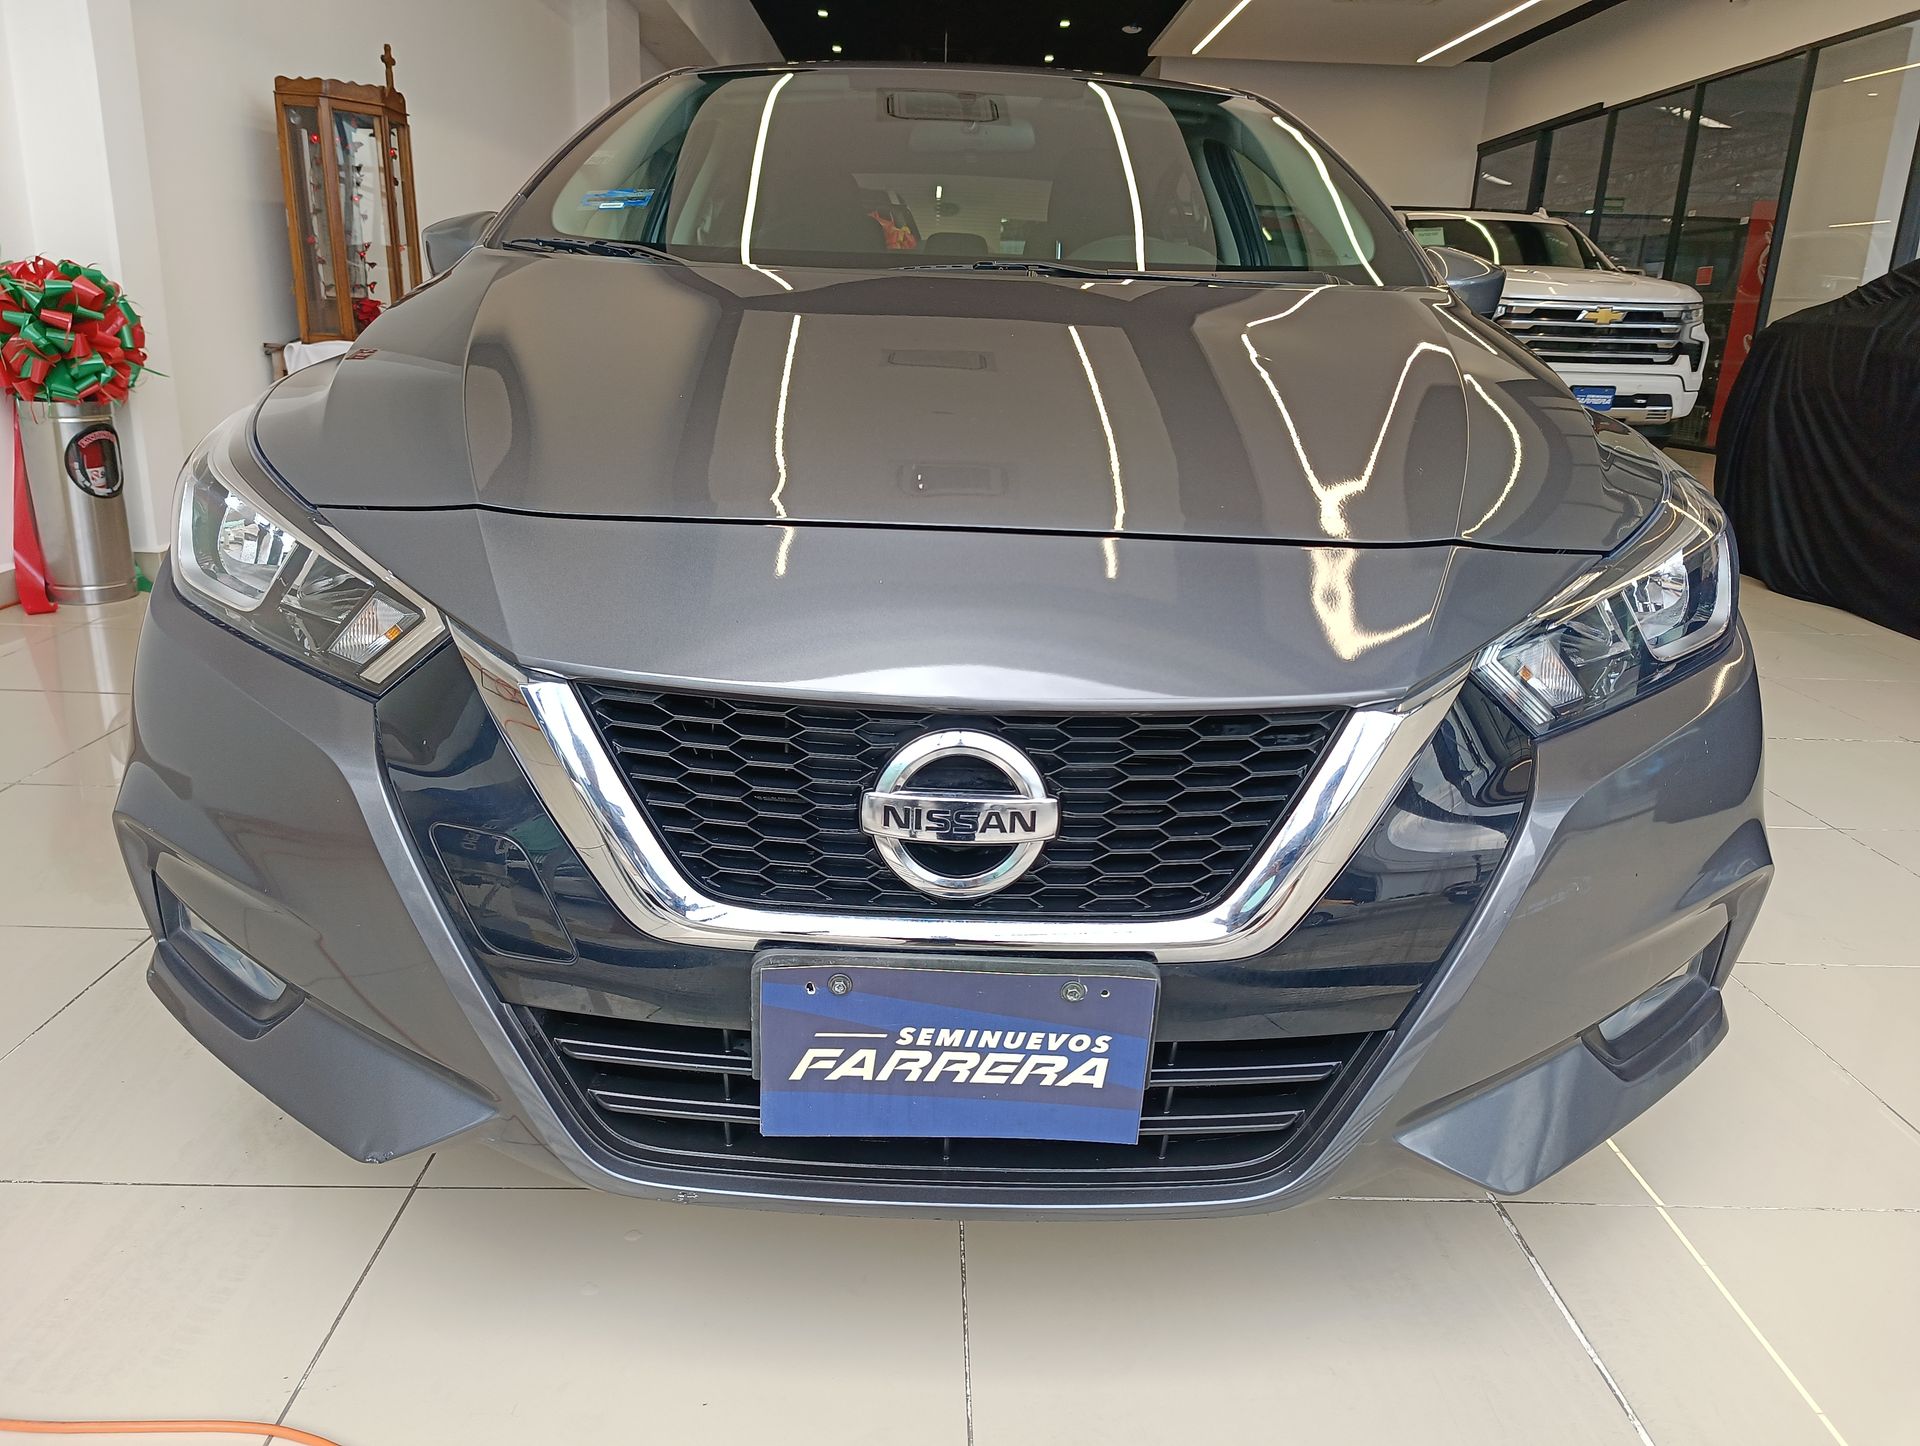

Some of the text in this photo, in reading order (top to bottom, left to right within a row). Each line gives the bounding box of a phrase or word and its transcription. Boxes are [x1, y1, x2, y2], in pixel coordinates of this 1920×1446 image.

[882, 805, 1038, 834] NISSAN
[895, 1026, 1113, 1054] SEMINUEVOS
[788, 1049, 1110, 1089] FARRERA
